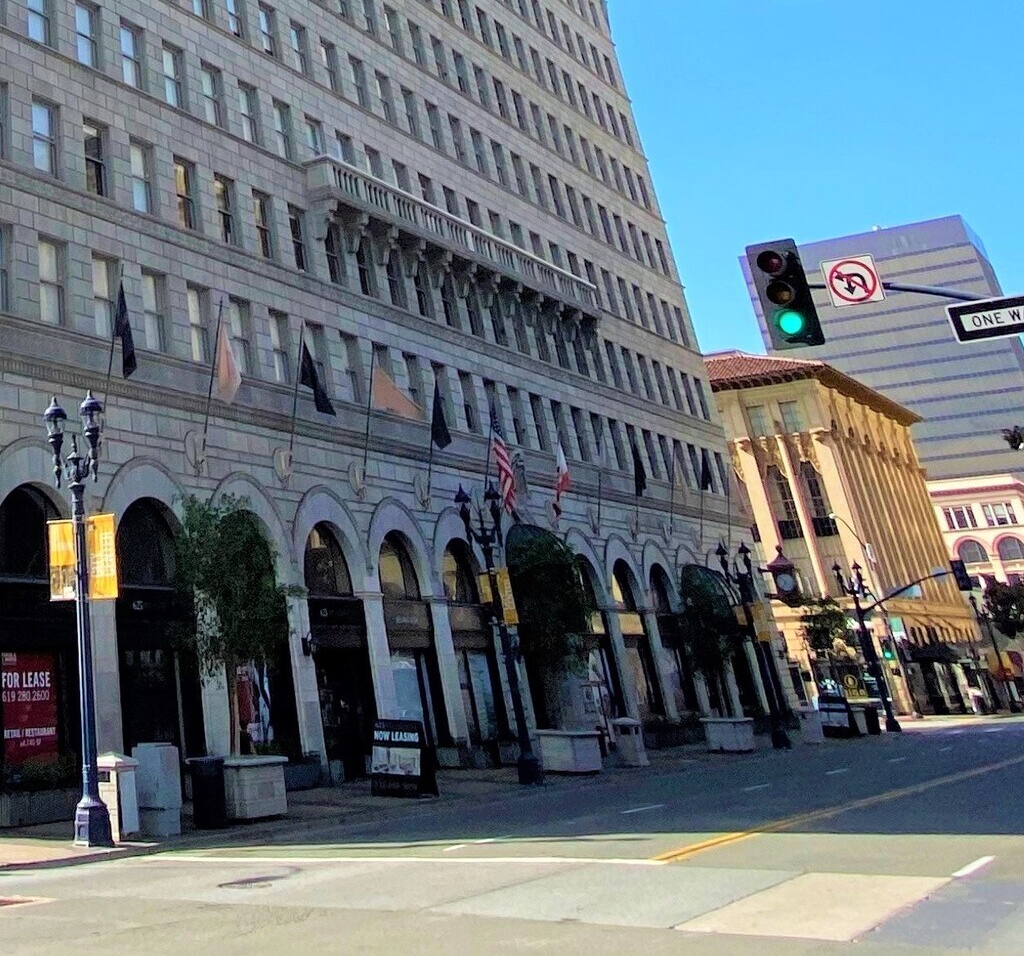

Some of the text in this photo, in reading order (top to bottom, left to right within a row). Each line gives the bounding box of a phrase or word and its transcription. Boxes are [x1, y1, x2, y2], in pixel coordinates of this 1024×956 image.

[972, 312, 1005, 328] ONE
[2, 672, 51, 689] FOR LEASE
[374, 730, 419, 742] NOW LEASING
